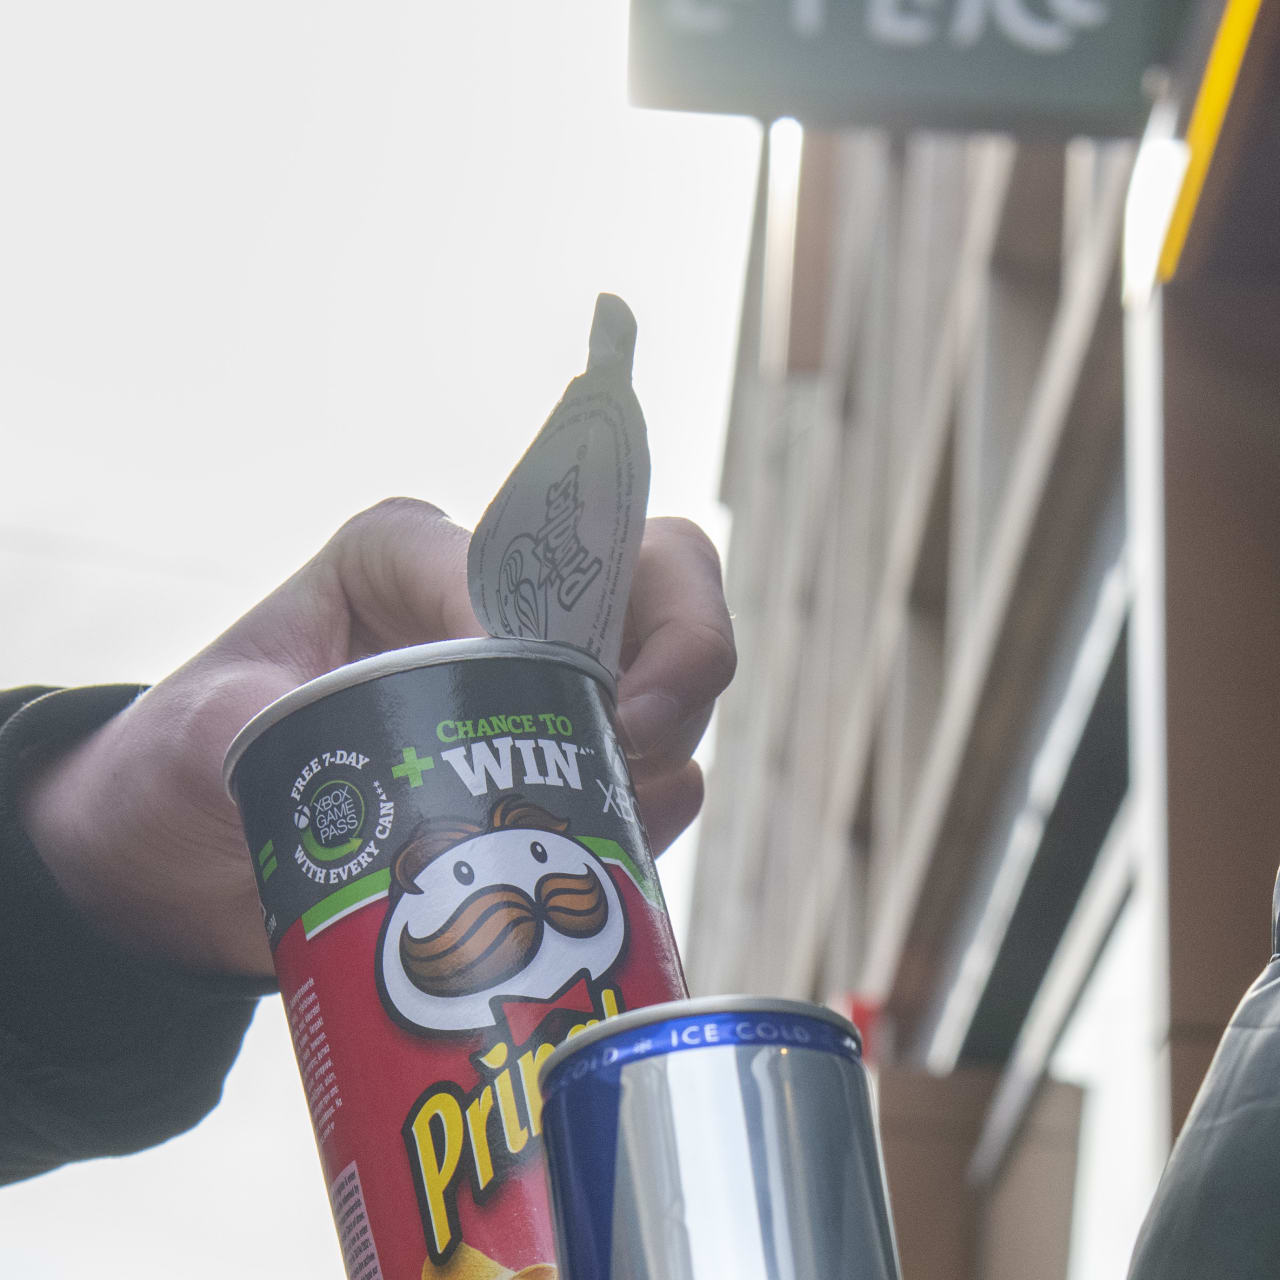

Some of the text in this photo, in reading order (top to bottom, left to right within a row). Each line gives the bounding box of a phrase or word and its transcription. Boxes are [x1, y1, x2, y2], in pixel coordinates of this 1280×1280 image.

[436, 713, 573, 743] CHANCE TO
[290, 750, 370, 801] FREE 7-DAY
[440, 736, 583, 797] WIN
[313, 785, 353, 816] XBOX
[316, 799, 356, 829] GAME
[293, 801, 395, 884] WITH EVERY CAN
[319, 813, 358, 845] PASS
[670, 1023, 721, 1047] ICE
[736, 1021, 812, 1044] COLD
